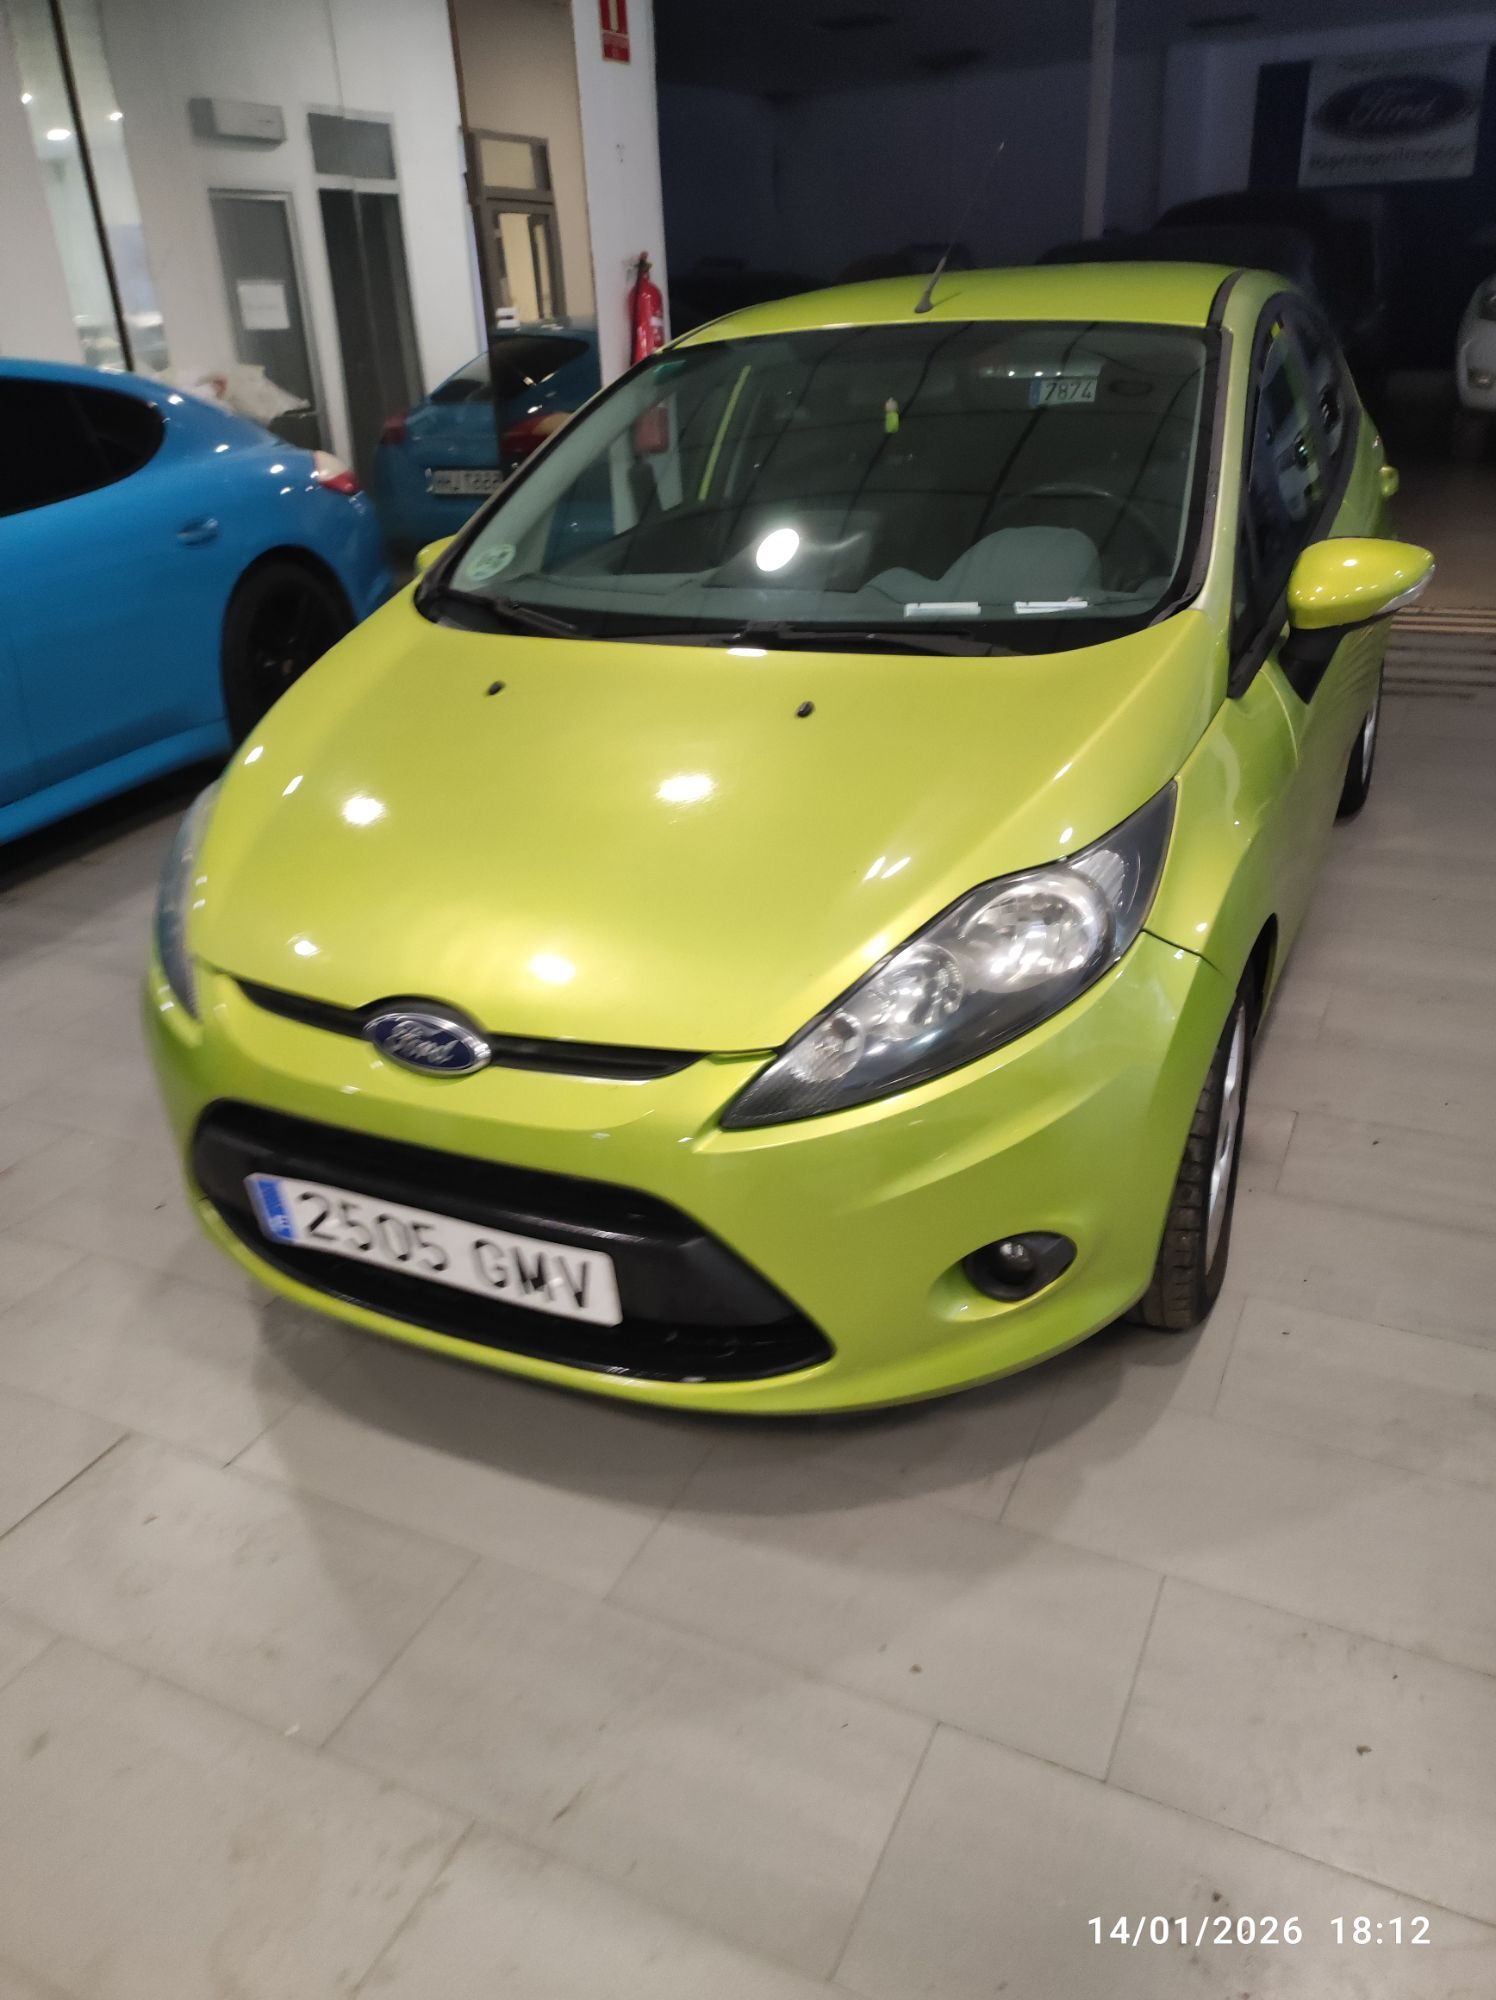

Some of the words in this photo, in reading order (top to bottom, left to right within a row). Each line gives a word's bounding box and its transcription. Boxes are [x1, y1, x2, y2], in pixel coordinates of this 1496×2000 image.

[1045, 381, 1093, 401] 7874
[382, 1020, 461, 1065] Ford
[297, 1190, 448, 1272] 2505
[471, 1237, 592, 1309] GMV
